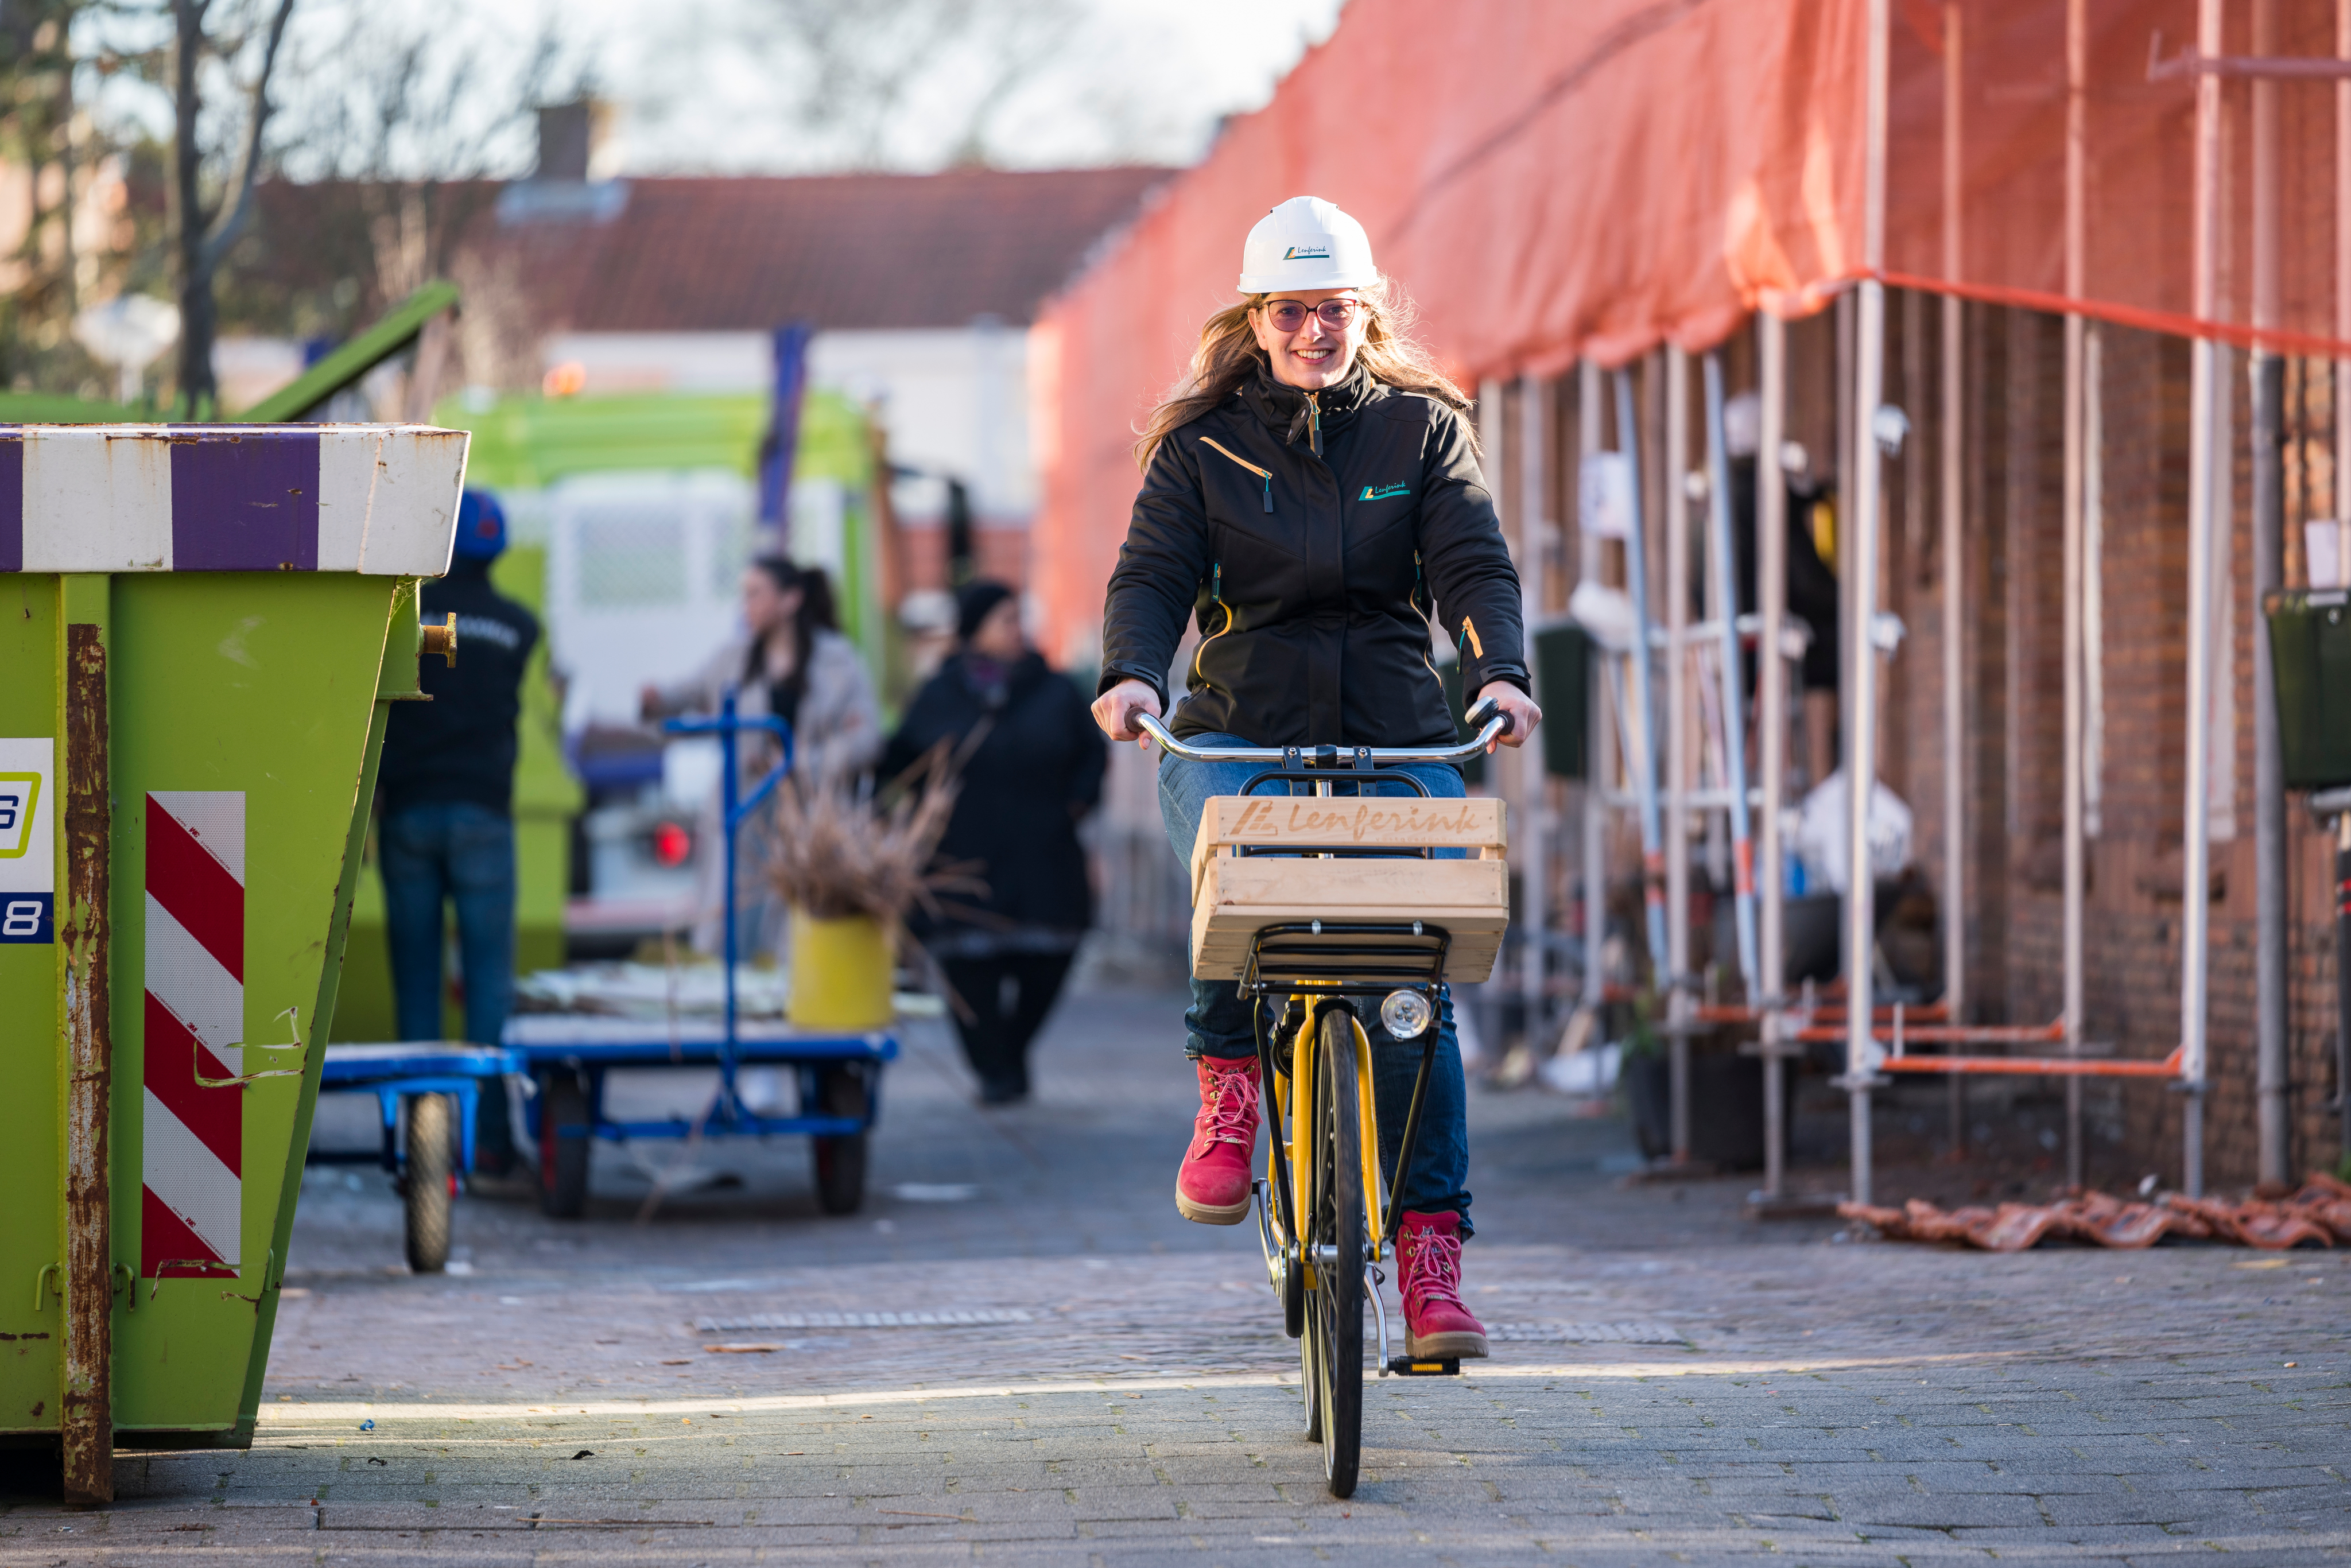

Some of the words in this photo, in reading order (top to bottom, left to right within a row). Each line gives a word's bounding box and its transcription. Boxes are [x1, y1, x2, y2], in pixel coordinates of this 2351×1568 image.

[1298, 246, 1326, 255] Lenferink
[1375, 480, 1406, 494] Lenferink
[1287, 804, 1479, 842] Lenferink
[189, 827, 200, 838] 3M
[3, 901, 42, 936] 8
[187, 1022, 197, 1033] 3M
[185, 1217, 196, 1228] 3M
